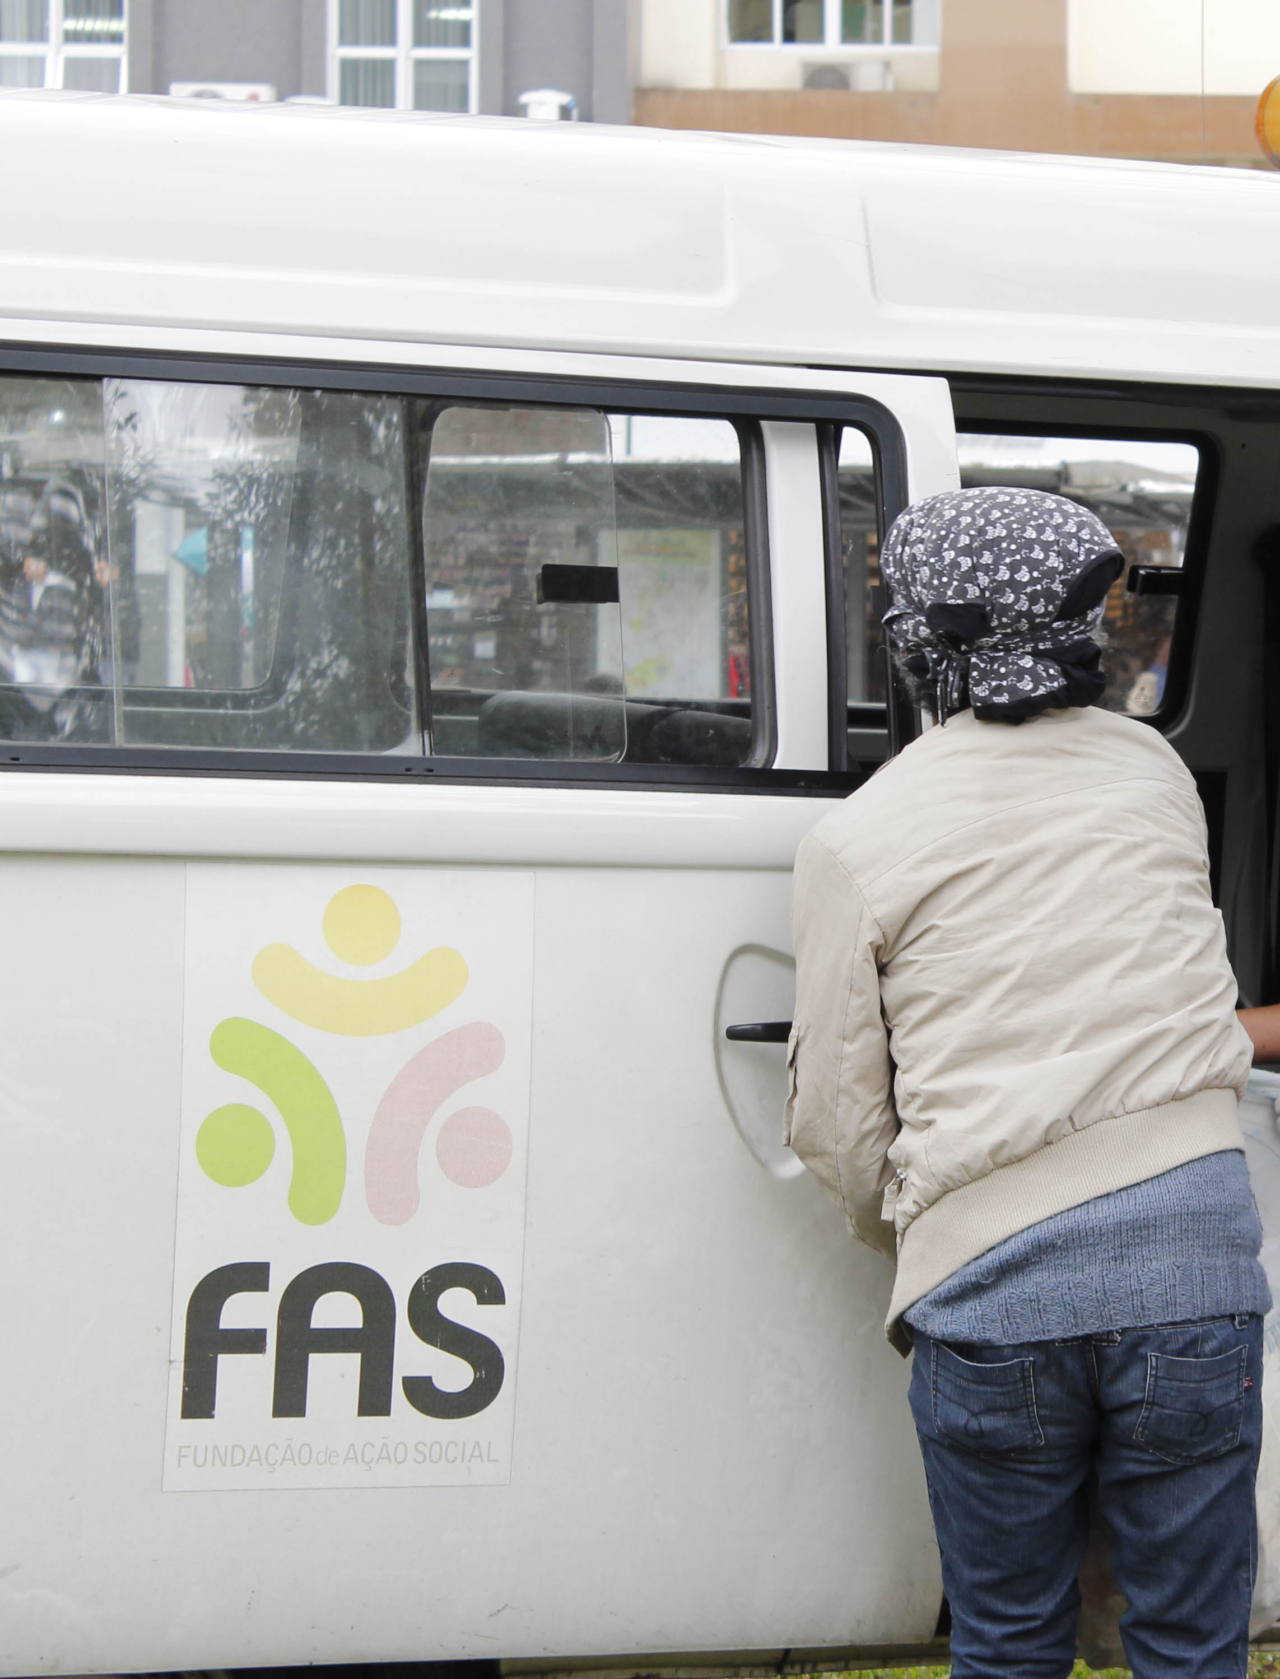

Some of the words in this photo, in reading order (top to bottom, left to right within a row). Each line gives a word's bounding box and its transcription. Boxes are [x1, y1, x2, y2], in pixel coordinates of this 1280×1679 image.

[180, 1261, 506, 1420] FAS
[176, 1438, 313, 1473] FUNDAÇÃO
[315, 1444, 340, 1467] de
[342, 1436, 408, 1472] AÇÃO
[412, 1440, 501, 1465] SOCIAL
